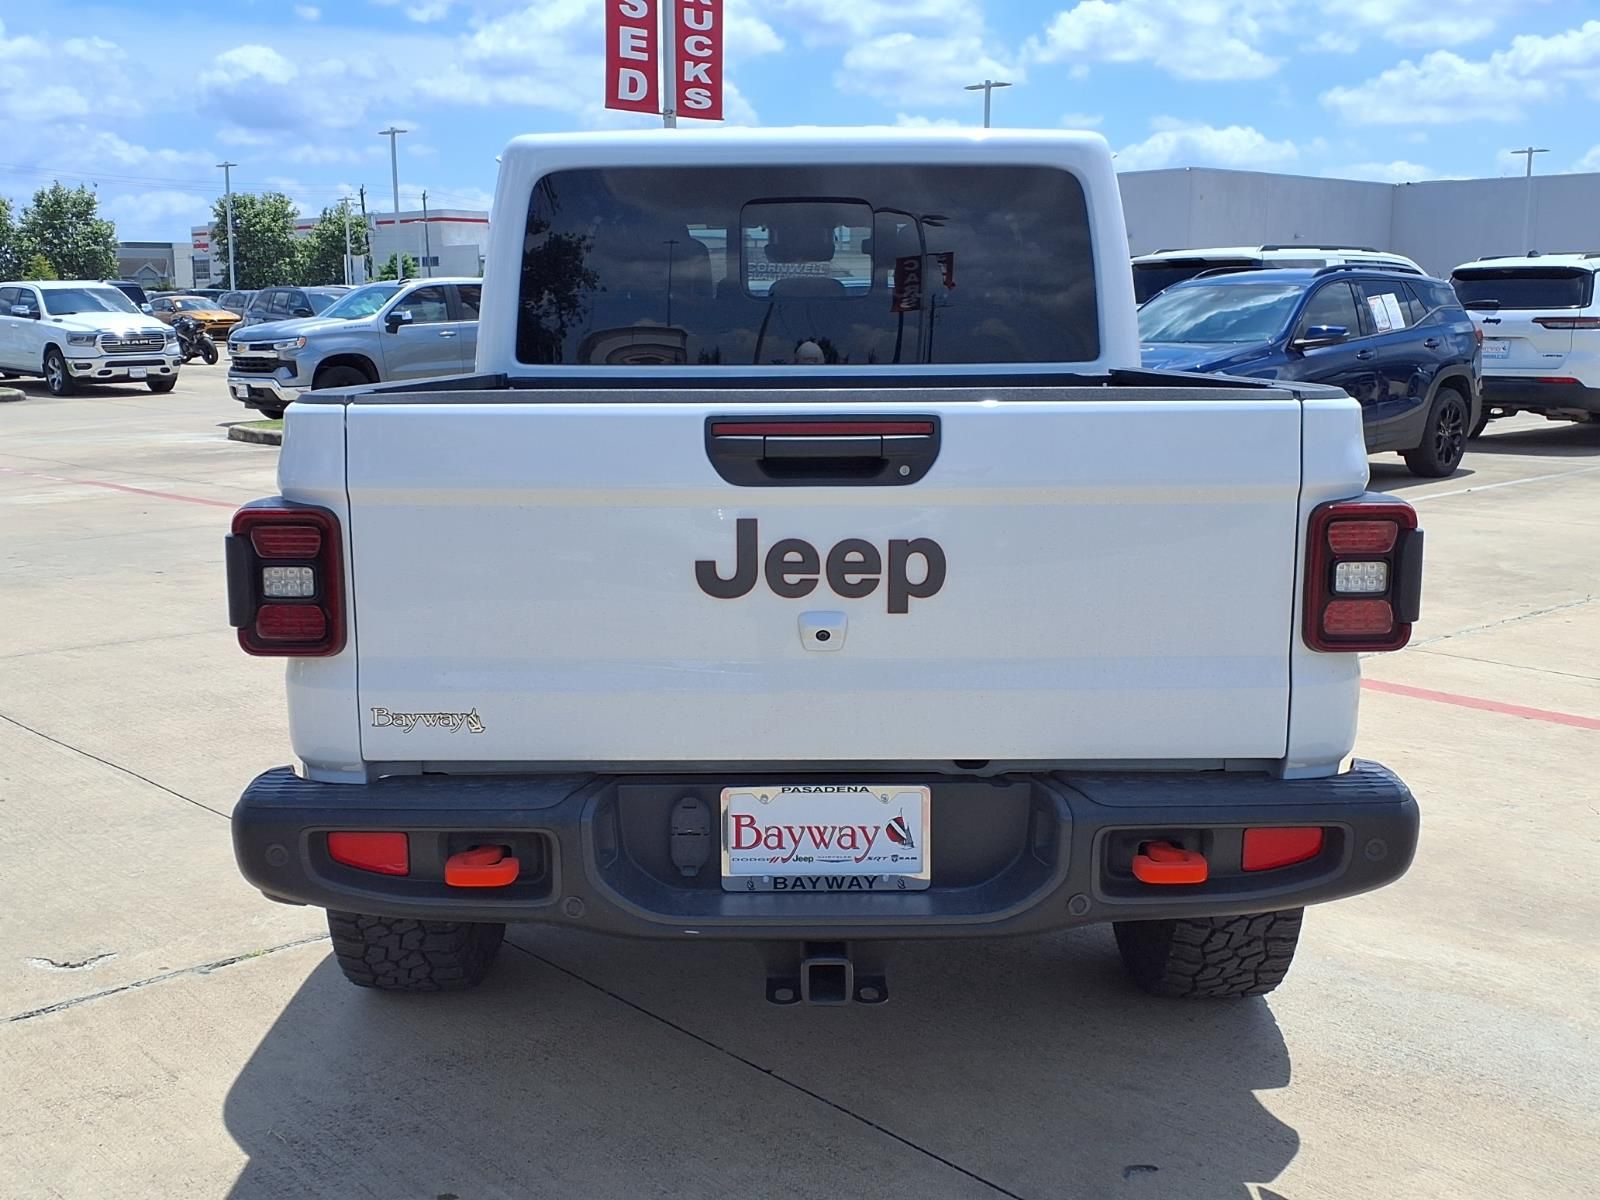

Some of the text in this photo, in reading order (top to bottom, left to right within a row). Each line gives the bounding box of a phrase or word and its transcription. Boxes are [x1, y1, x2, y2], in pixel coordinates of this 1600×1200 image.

[683, 0, 713, 109] UCKS
[695, 518, 947, 614] Jeep
[370, 707, 467, 733] Bayway
[781, 786, 870, 794] PASADENA
[731, 814, 881, 863] Bayway
[792, 855, 814, 864] Jeep
[773, 876, 879, 890] BAYWAY
